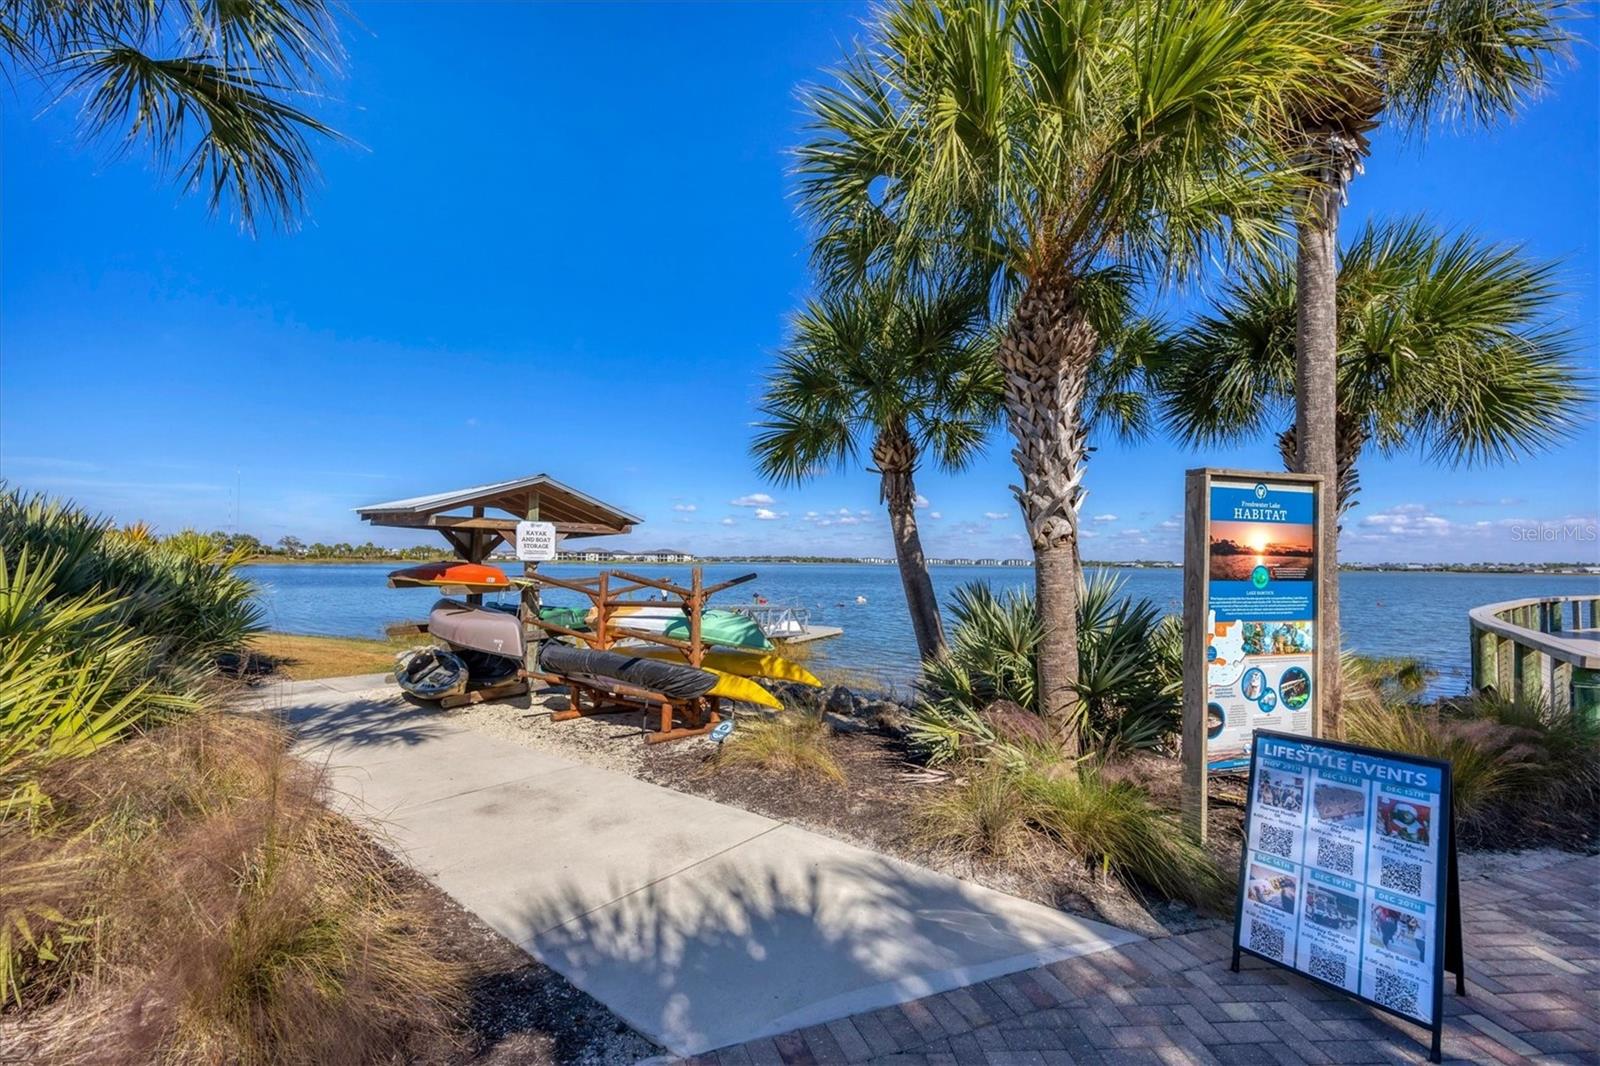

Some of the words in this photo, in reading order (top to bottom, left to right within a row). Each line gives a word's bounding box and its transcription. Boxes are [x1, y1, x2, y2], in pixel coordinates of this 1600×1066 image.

[1234, 508, 1288, 520] HABITAT
[1264, 759, 1280, 767] NOV
[1264, 742, 1346, 770] LIFESTYLE
[1351, 759, 1427, 787] EVENTS
[1385, 784, 1402, 794] DEC
[1257, 853, 1272, 864] DEC
[1314, 871, 1330, 882] DEC
[1378, 891, 1395, 903] DEC
[1397, 897, 1421, 911] 20TH
